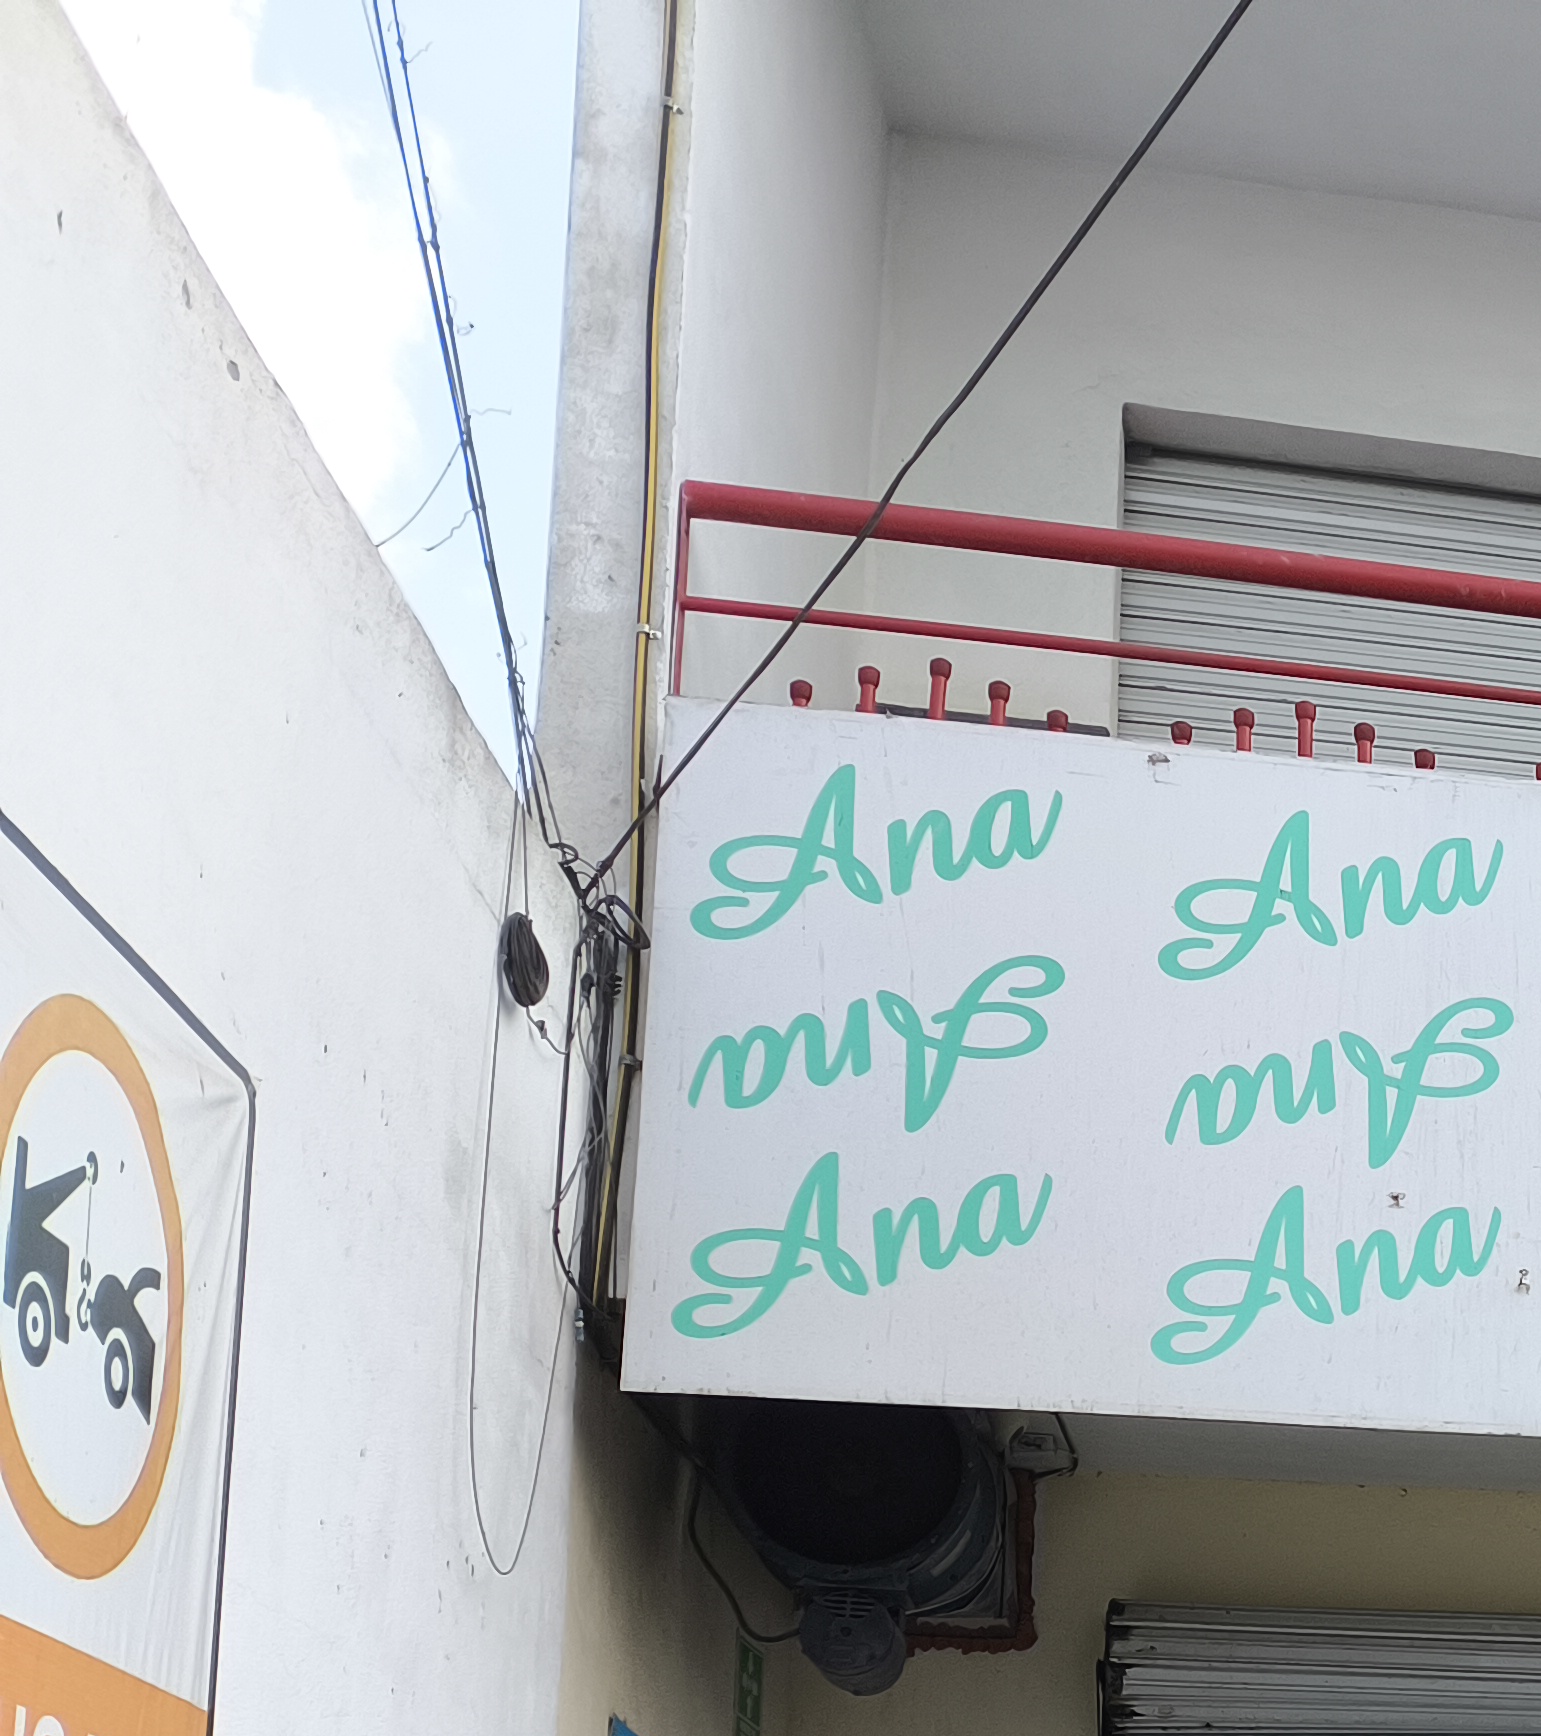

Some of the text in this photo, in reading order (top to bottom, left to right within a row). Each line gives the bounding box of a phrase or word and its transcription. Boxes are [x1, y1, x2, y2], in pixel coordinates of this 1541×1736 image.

[691, 765, 1062, 940] Ana
[1158, 811, 1503, 980] Ana
[689, 956, 1065, 1132] Ana
[1166, 999, 1514, 1169] Ana
[672, 1153, 1052, 1339] Ana
[1152, 1187, 1502, 1365] Ana
